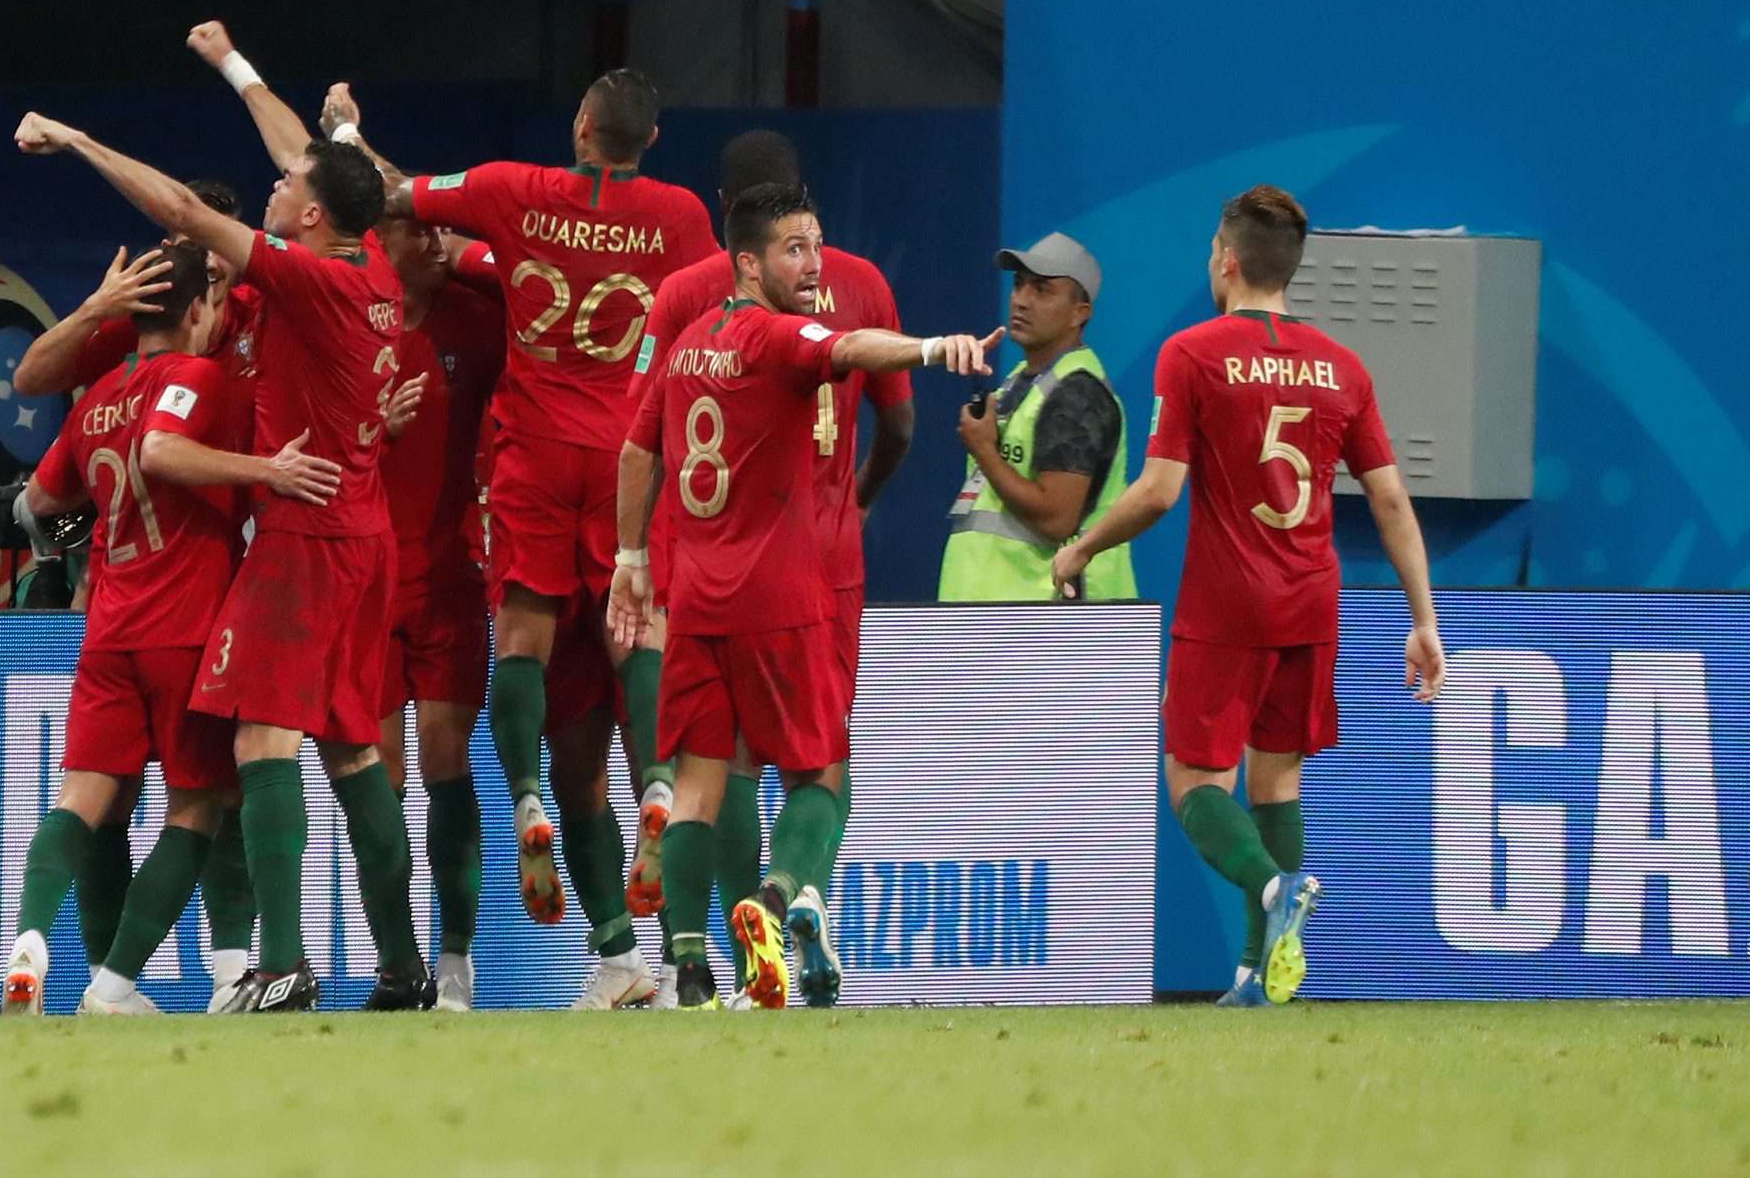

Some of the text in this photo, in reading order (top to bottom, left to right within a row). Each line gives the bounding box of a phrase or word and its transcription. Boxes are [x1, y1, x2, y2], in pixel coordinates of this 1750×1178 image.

[521, 209, 666, 255] QUARESMA
[368, 300, 398, 332] PEPE
[510, 258, 655, 363] 20
[1224, 357, 1340, 391] RAPHAEL
[87, 437, 165, 566] 21
[678, 395, 730, 519] 8
[1250, 405, 1313, 530] 5
[211, 627, 234, 676] 3
[1435, 648, 1731, 956] GA
[830, 859, 1049, 970] AZPROM
